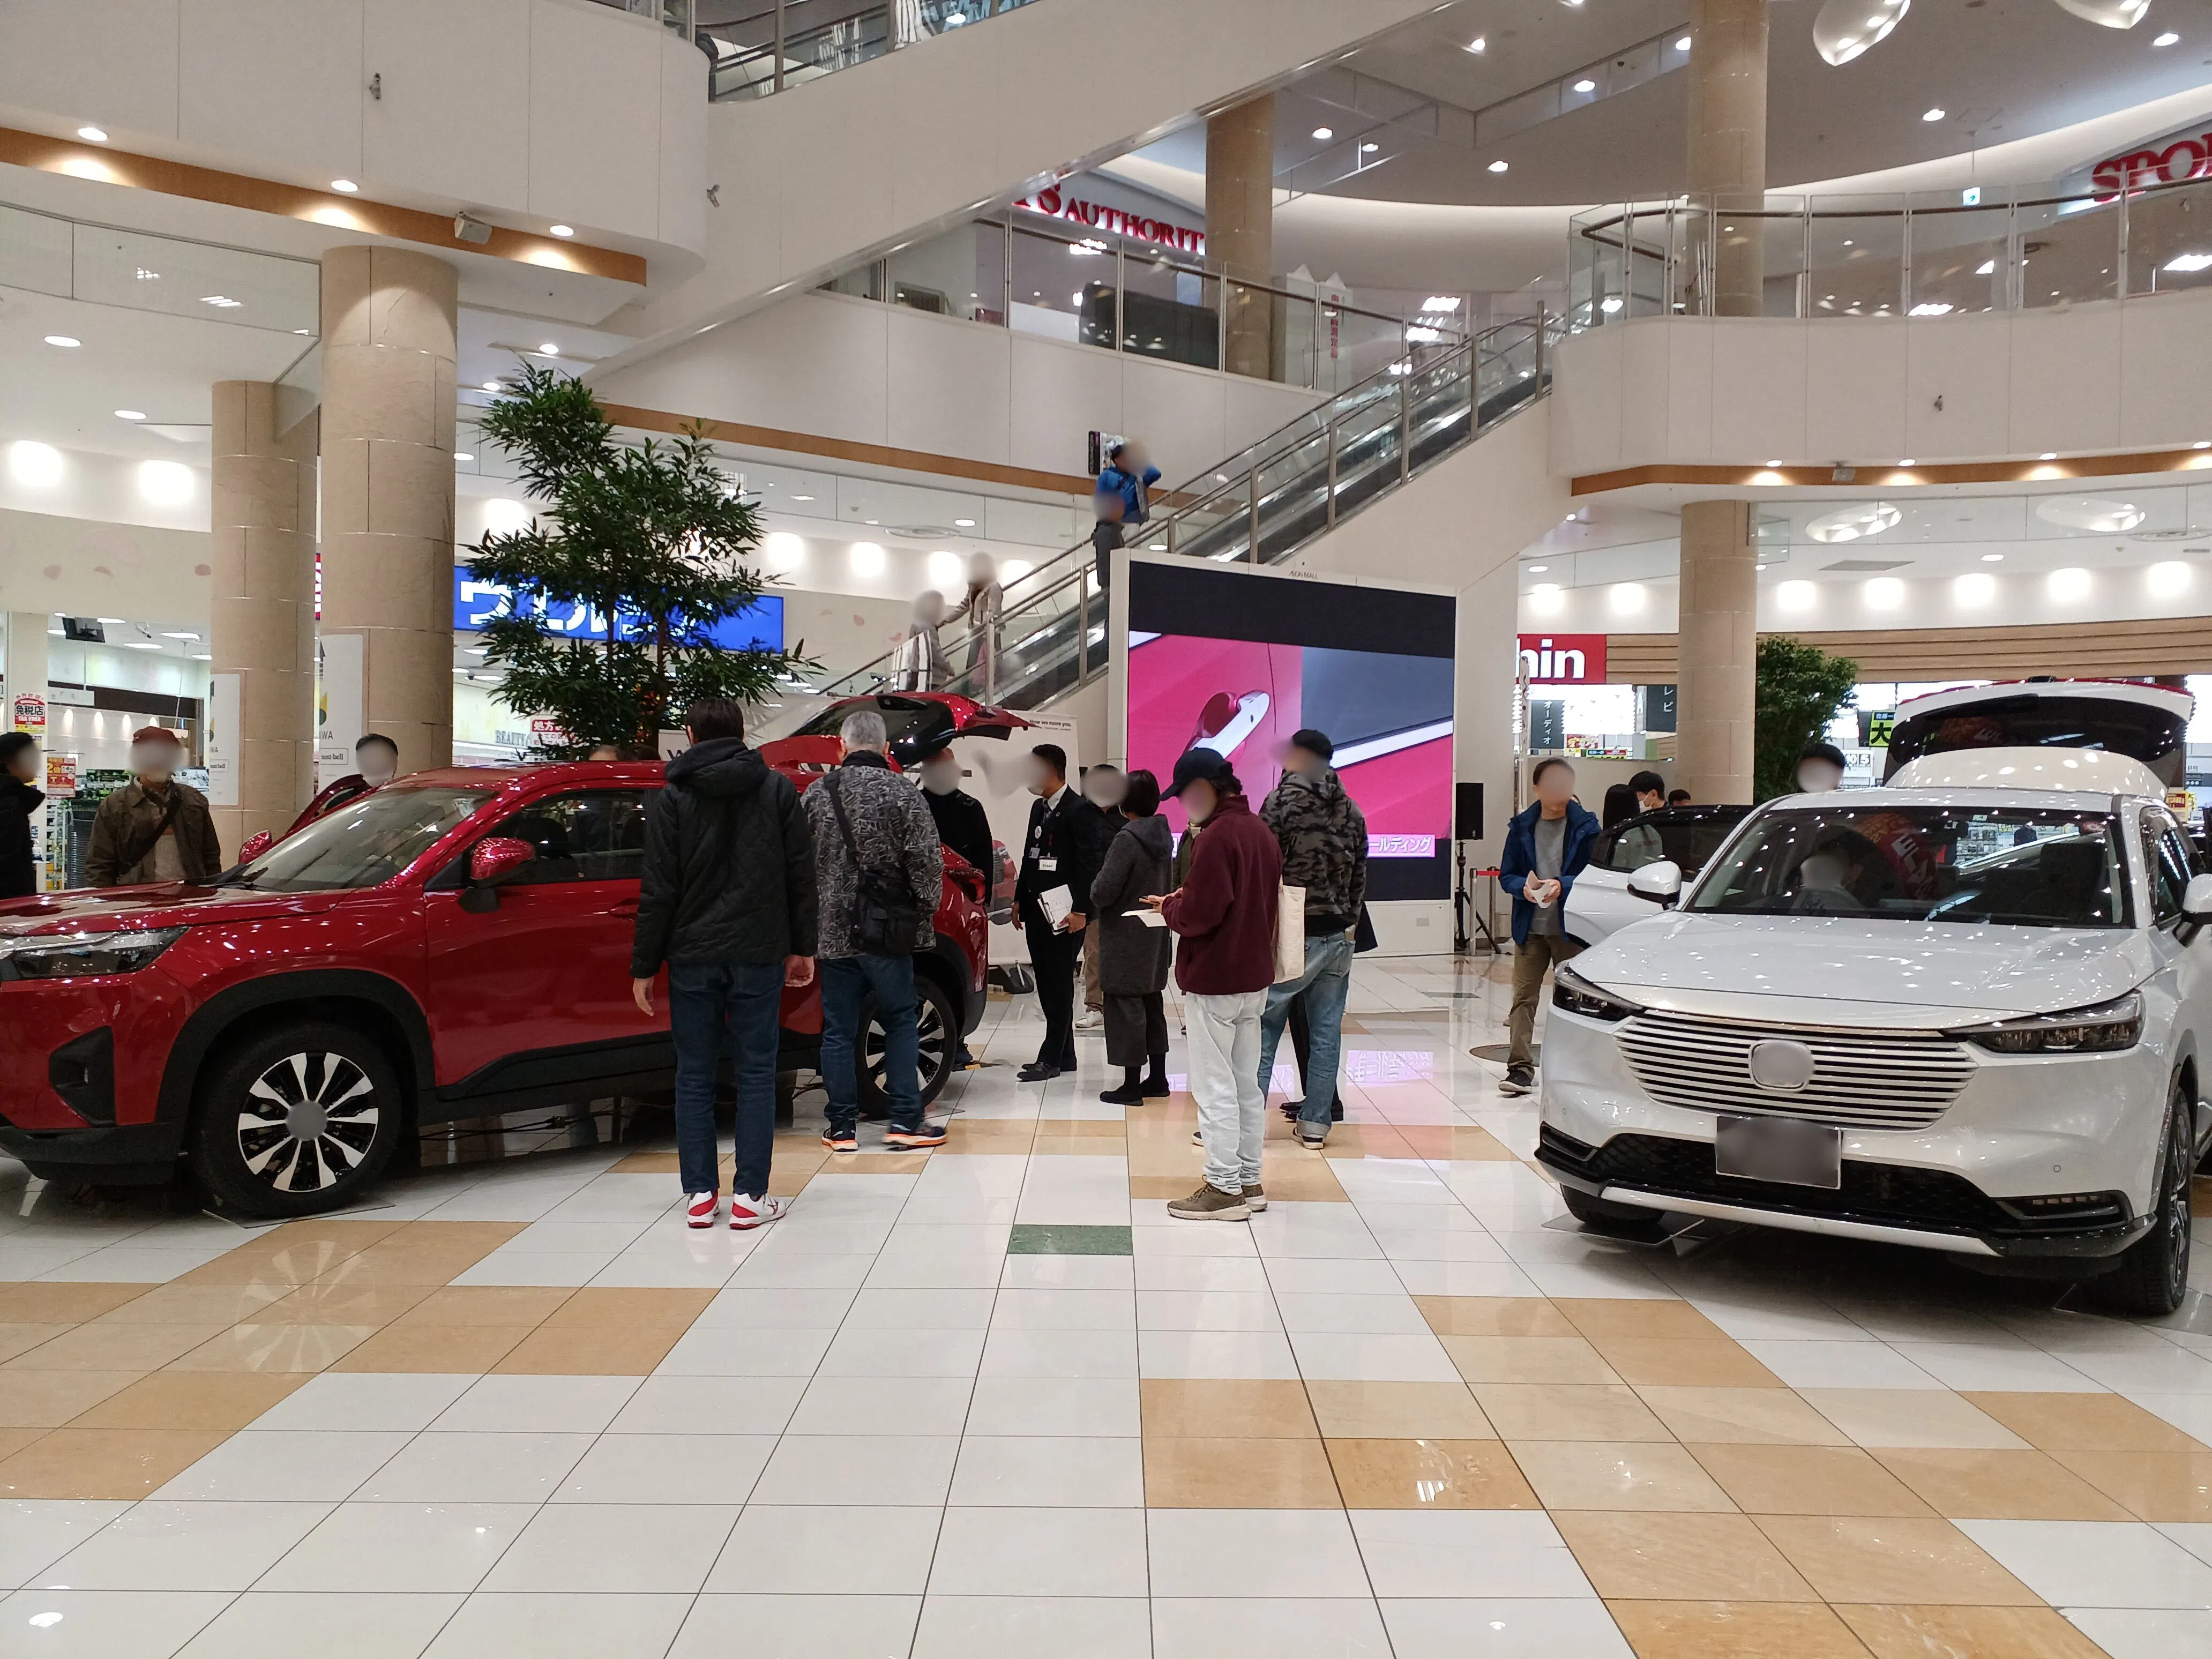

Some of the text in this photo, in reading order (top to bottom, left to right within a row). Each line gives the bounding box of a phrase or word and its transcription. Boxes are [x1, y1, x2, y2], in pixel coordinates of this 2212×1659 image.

[16, 705, 43, 715] 免税店
[1543, 700, 1553, 745] オーディオ
[495, 730, 526, 746] BEAUTY
[1859, 753, 1870, 764] 5
